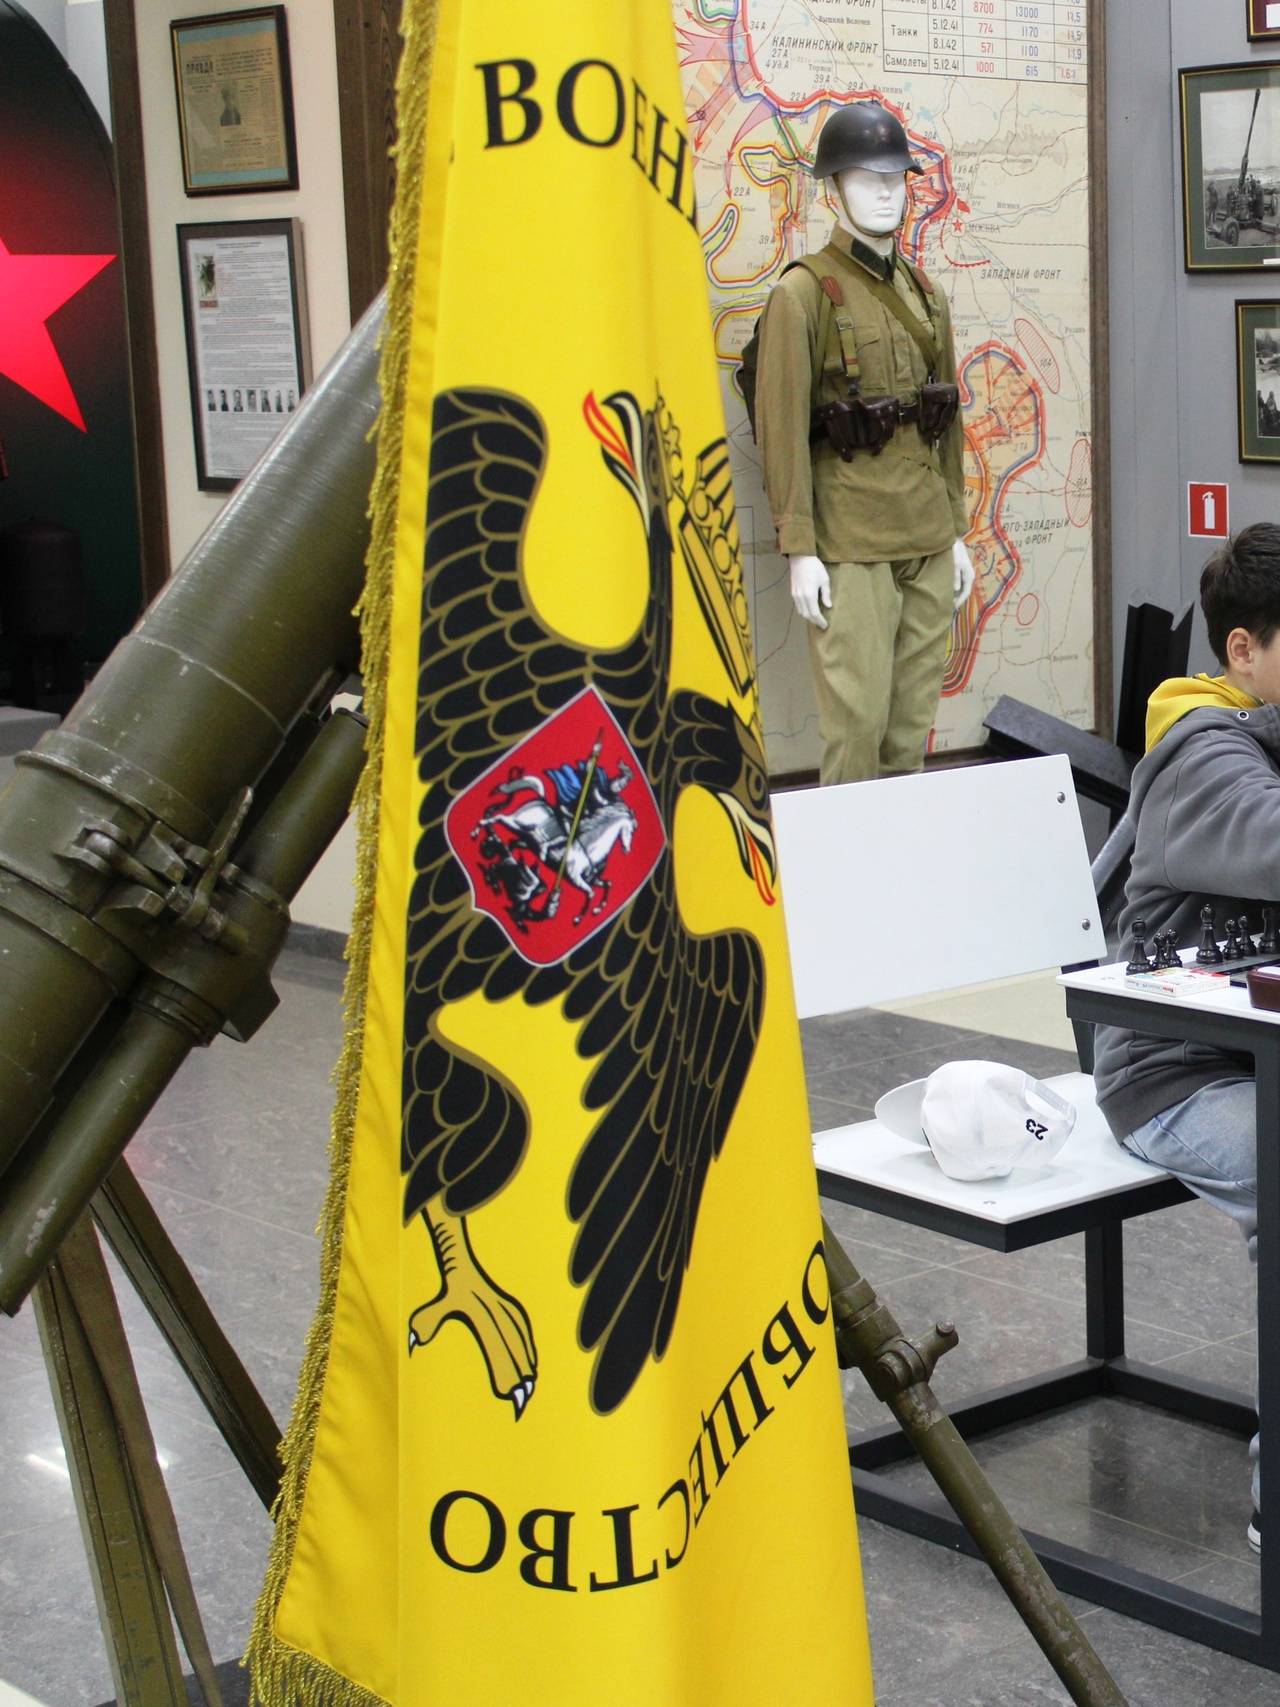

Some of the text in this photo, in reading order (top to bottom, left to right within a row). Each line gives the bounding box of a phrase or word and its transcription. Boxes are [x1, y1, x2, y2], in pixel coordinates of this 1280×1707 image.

[891, 24, 918, 37] Танки
[772, 36, 879, 54] КАЛИНИНСКИЙ ФРОНТ
[885, 53, 928, 68] Самолеты
[474, 58, 699, 236] ВОЕН
[980, 268, 1062, 281] ЗАПАДНЫЙ ФРОНТ
[1025, 532, 1053, 545] ФРОНТ
[1025, 1117, 1049, 1141] 23
[430, 1239, 831, 1593] ОБЩЕСТВО
